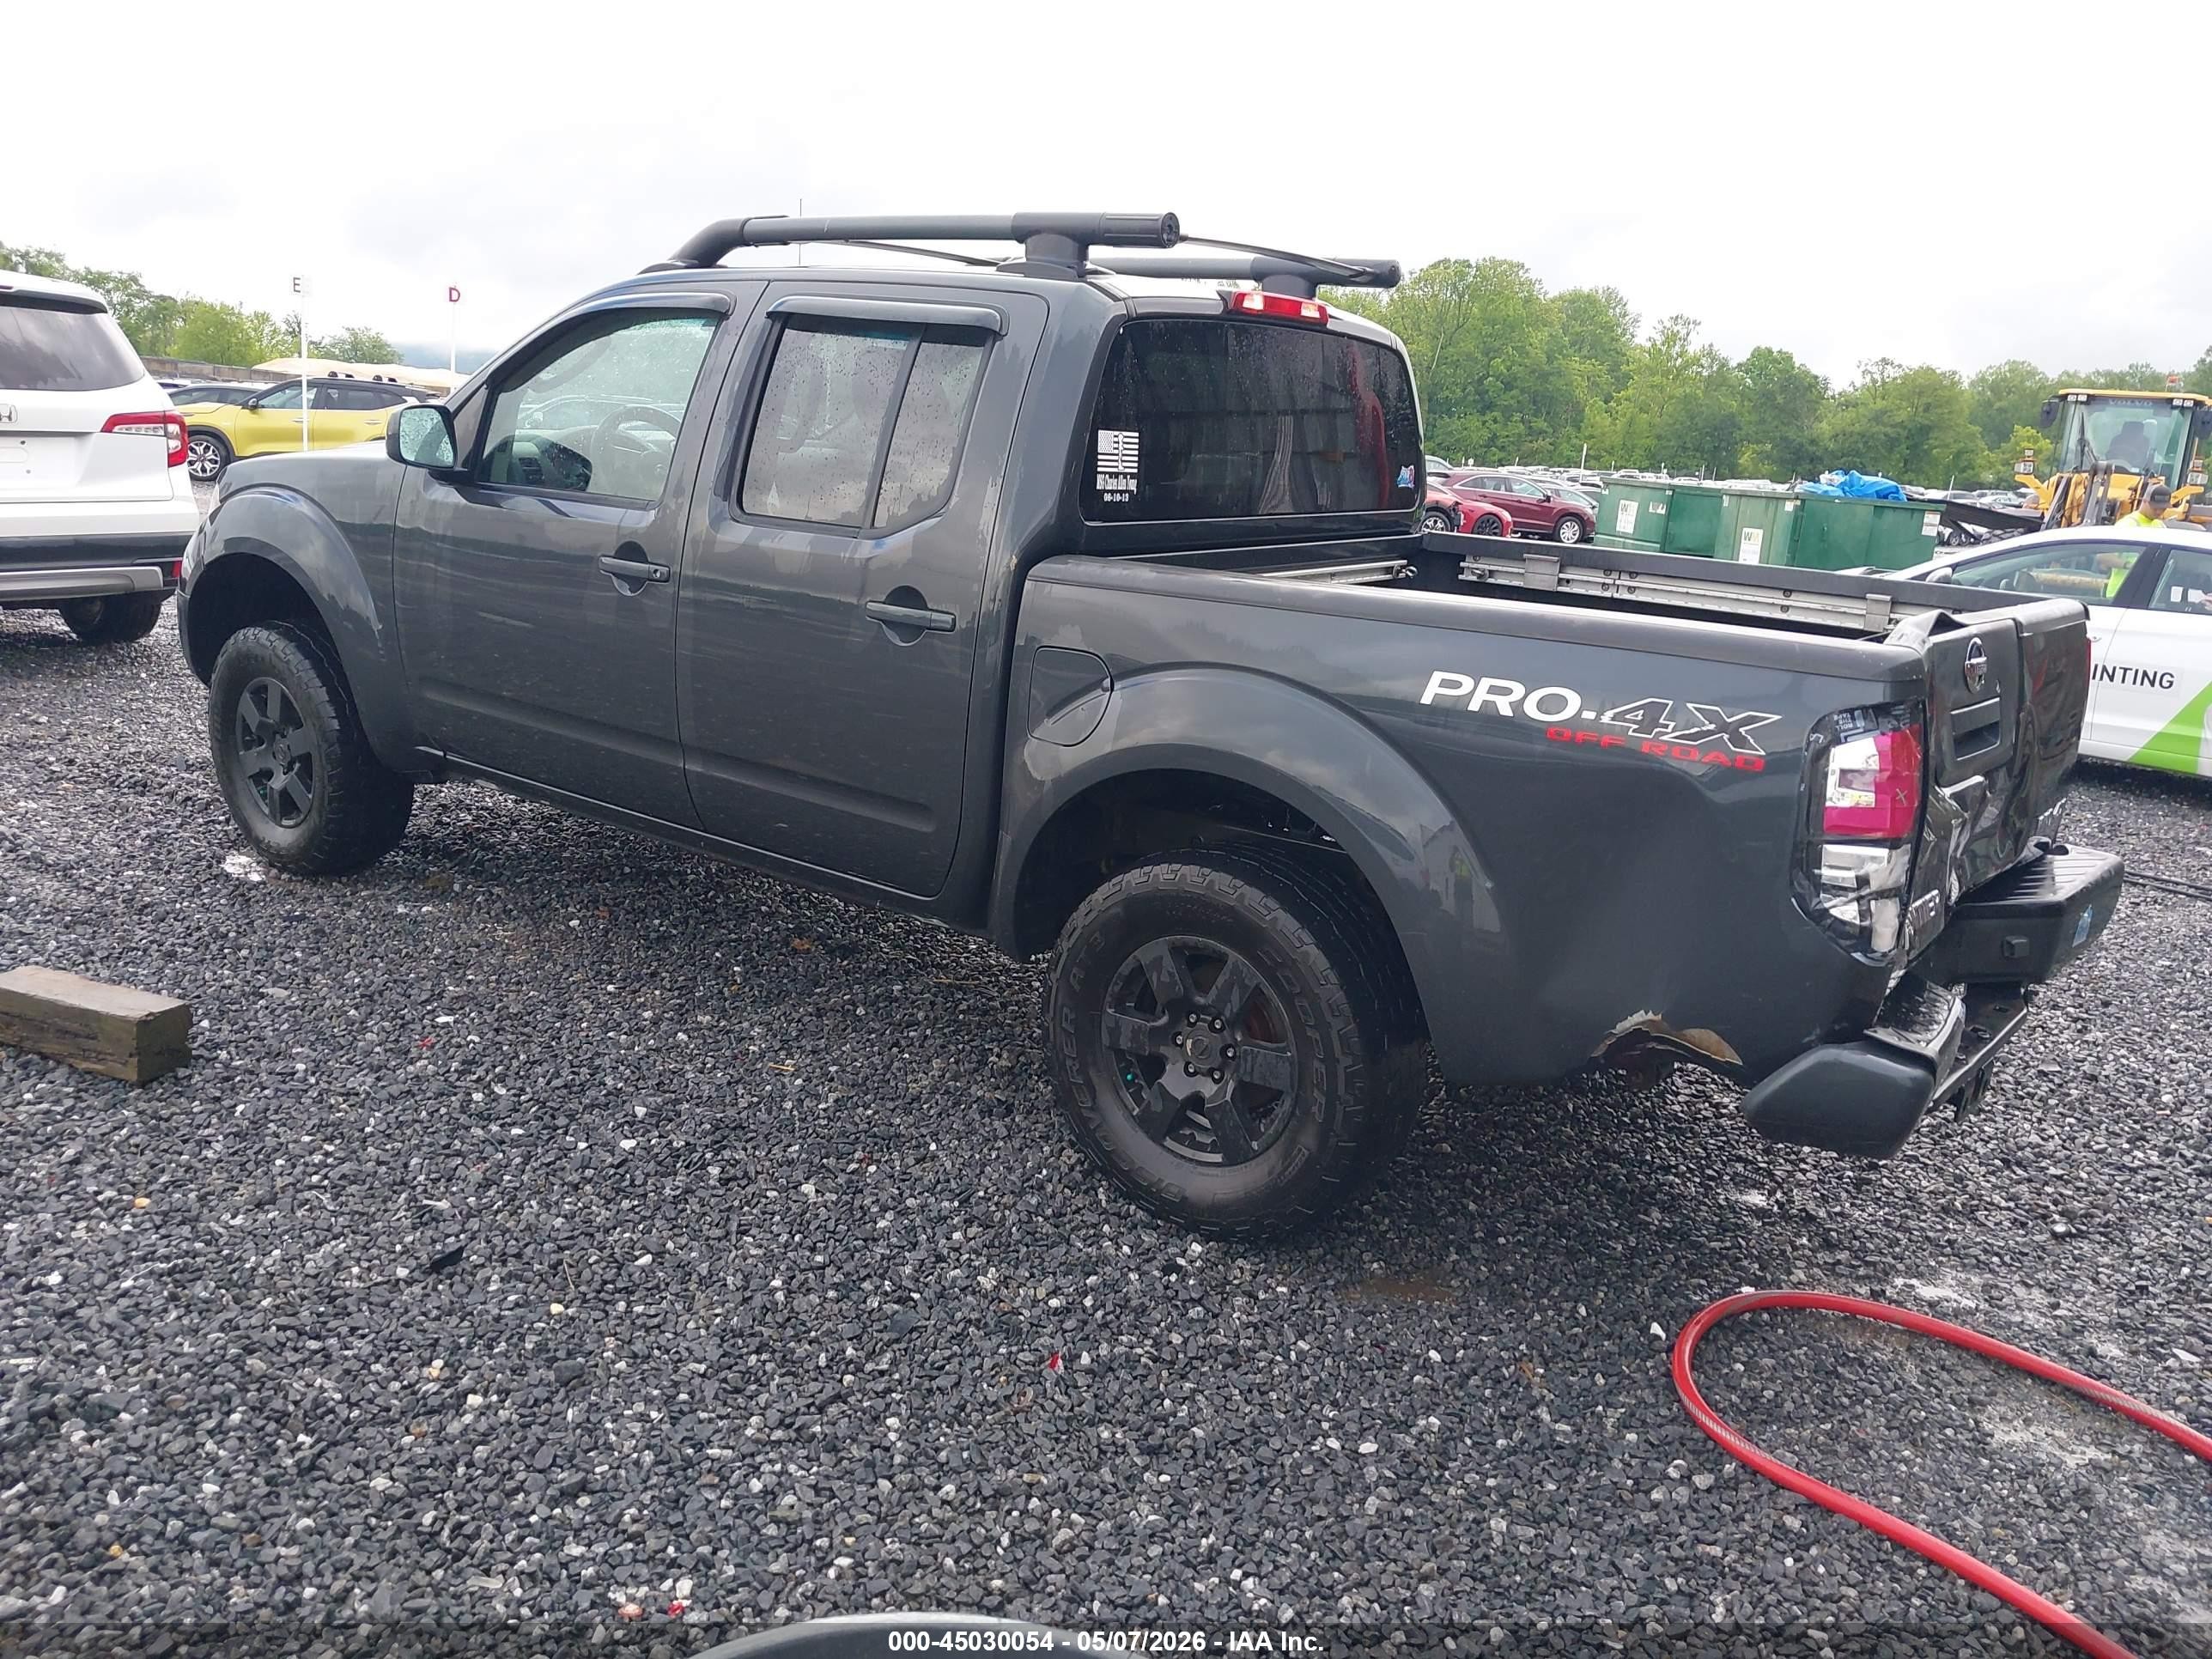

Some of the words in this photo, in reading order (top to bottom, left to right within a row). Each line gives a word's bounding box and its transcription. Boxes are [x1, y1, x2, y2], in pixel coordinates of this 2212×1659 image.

[293, 277, 301, 293] E
[448, 287, 460, 302] D
[2092, 664, 2175, 690] INTING
[1419, 671, 1783, 755] PRO-4X
[1547, 727, 1626, 747] OFF
[1641, 741, 1765, 771] ROAD
